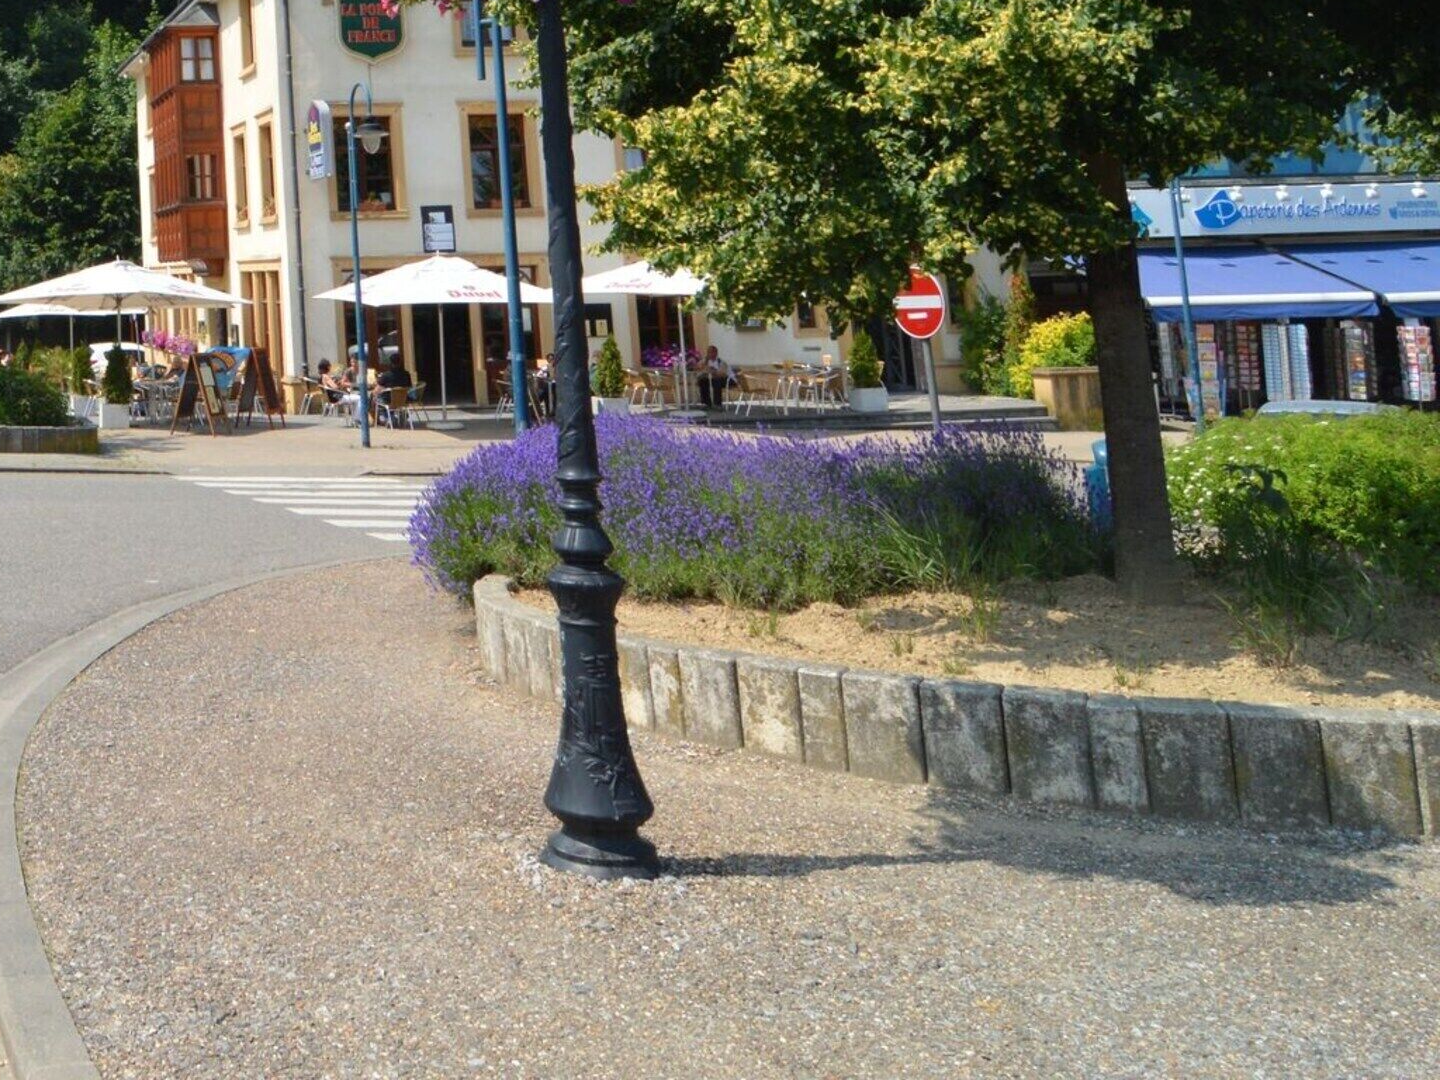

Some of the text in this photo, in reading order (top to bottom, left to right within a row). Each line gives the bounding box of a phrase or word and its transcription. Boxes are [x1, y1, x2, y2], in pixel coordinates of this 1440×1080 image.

[363, 17, 379, 29] DE
[348, 29, 396, 42] FRANCE
[1209, 195, 1381, 226] Papeterie des Ardennes
